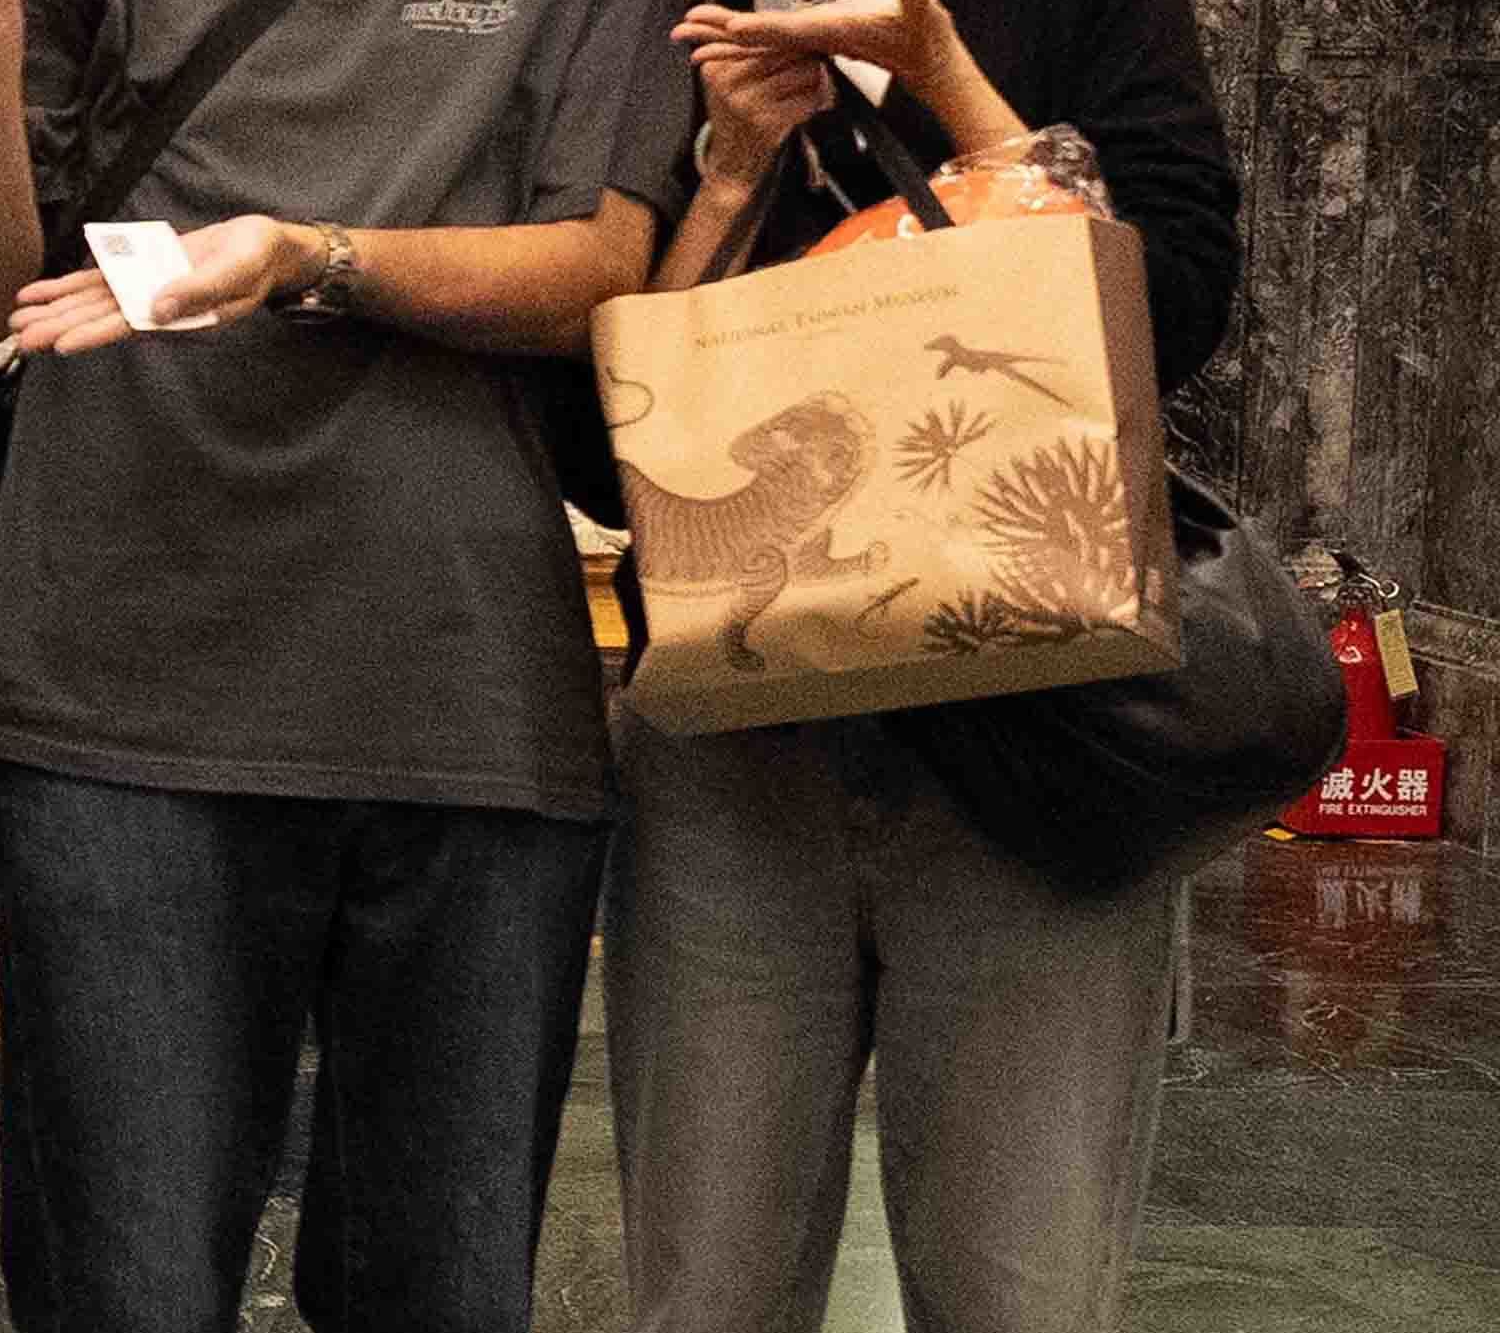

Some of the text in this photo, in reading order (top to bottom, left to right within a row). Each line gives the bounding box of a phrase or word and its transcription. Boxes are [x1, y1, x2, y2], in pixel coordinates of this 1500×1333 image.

[1321, 767, 1429, 802] 滅火器
[1319, 803, 1428, 817] FIRE EXTINGUISHER
